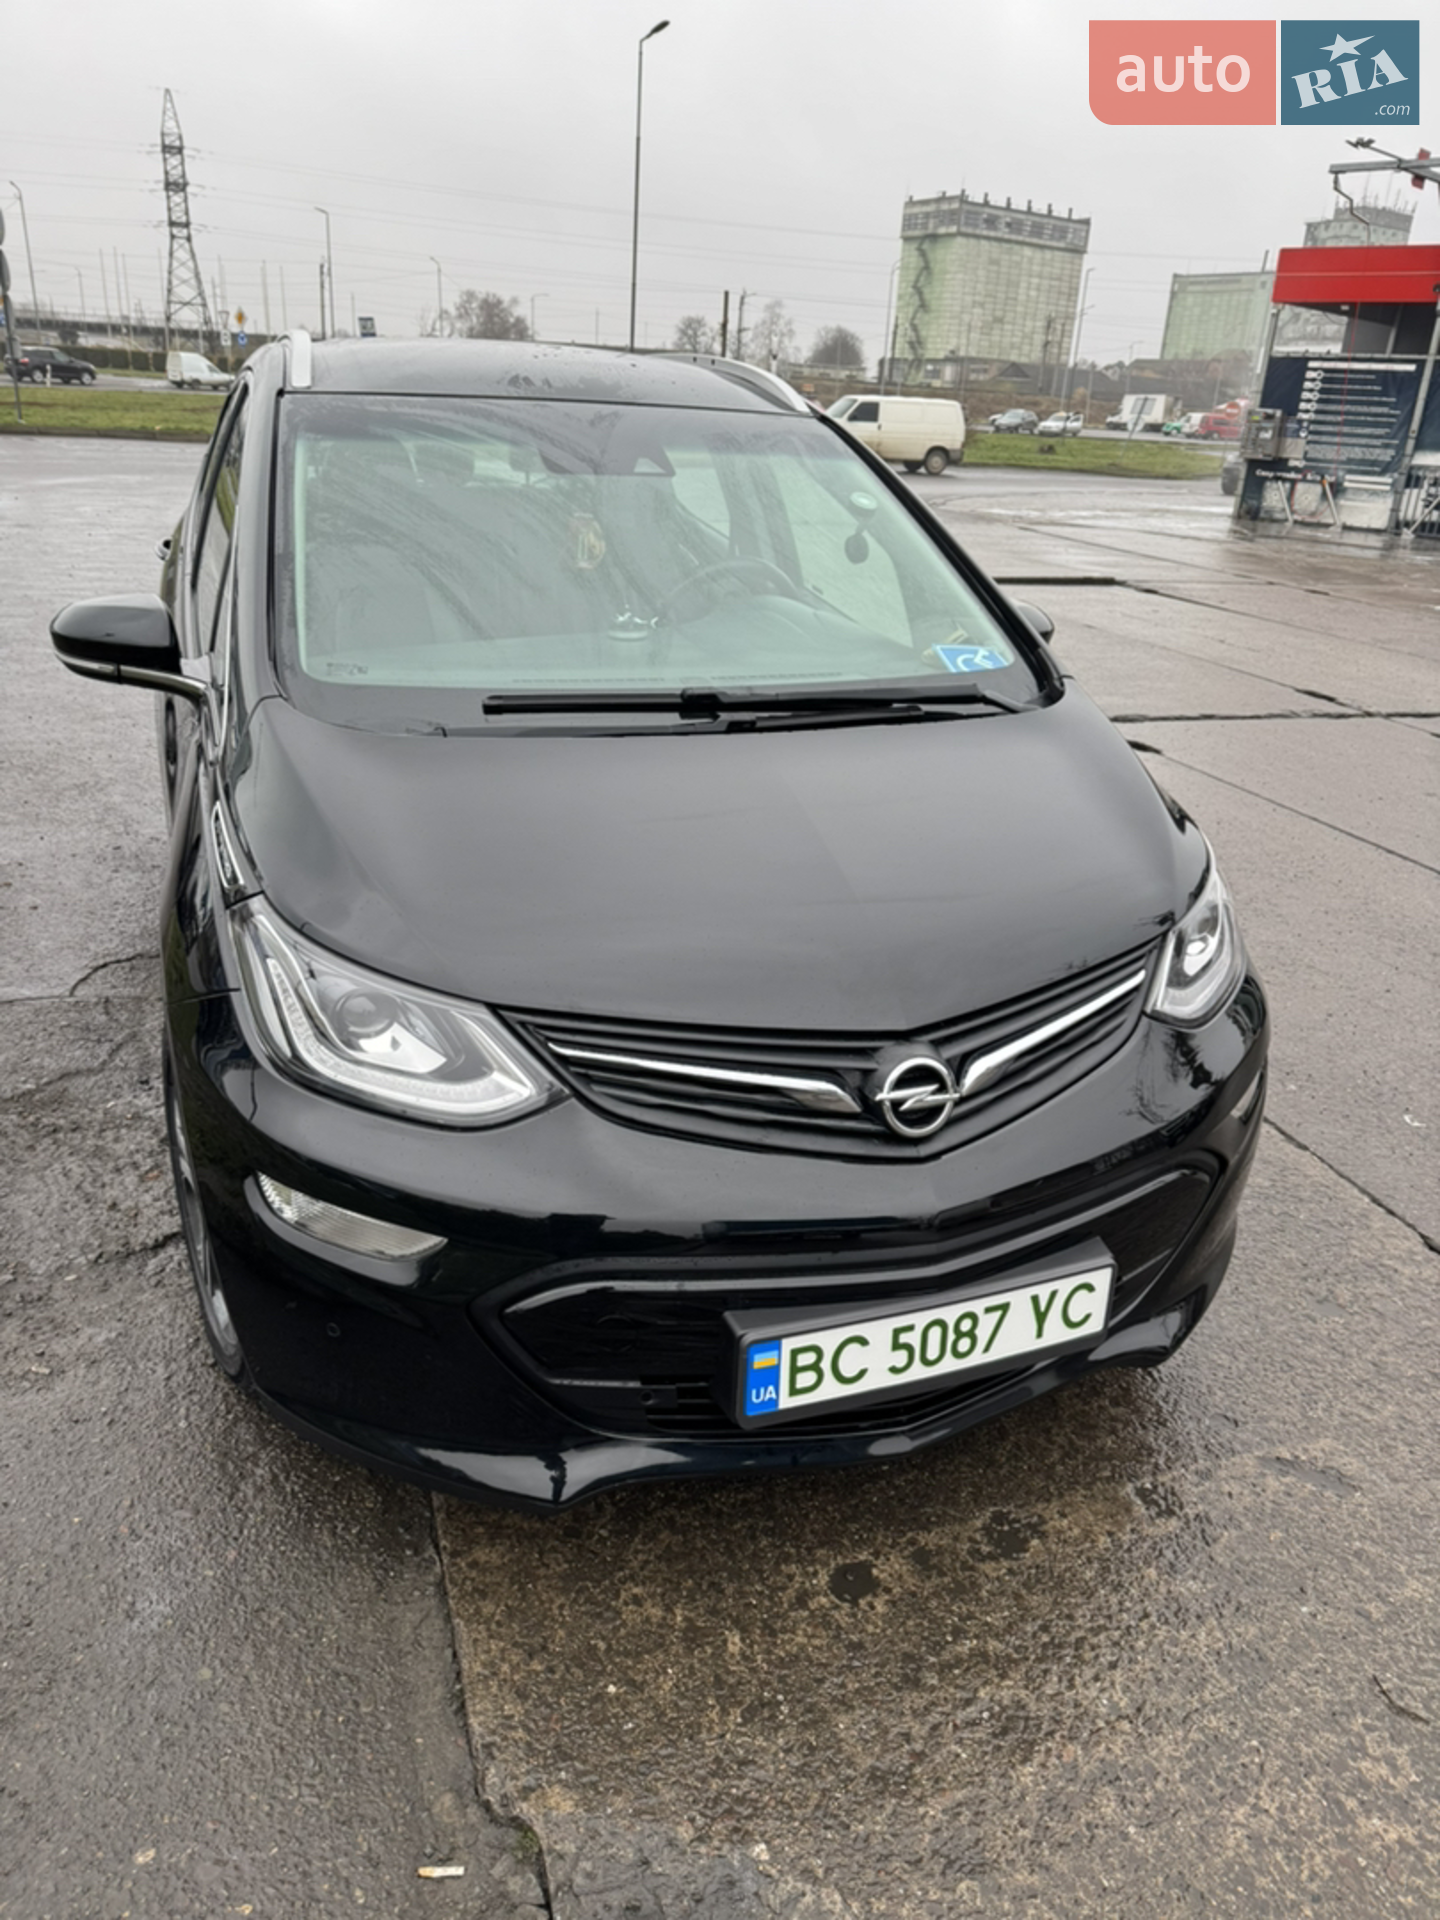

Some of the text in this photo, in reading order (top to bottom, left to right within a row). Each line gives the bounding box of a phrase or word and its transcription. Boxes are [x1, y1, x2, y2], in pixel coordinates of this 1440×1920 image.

[788, 1282, 1096, 1398] BC 5087 YC
[751, 1385, 777, 1404] UA
